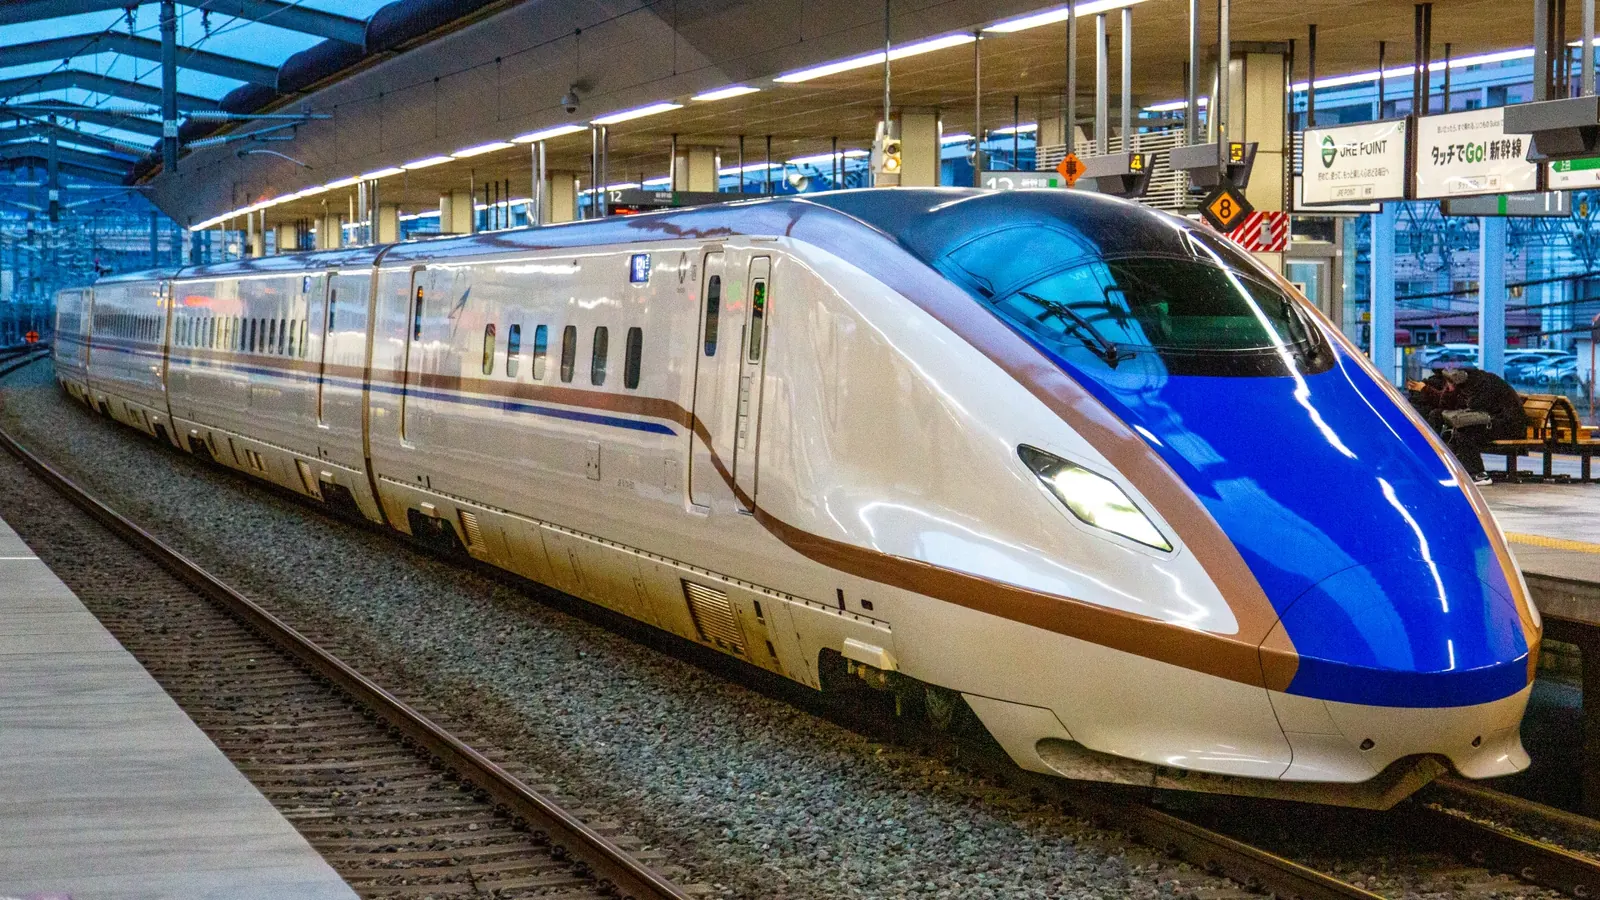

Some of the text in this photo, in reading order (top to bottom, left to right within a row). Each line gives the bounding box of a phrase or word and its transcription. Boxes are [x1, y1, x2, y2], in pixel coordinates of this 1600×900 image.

[1231, 143, 1242, 161] 5
[1360, 139, 1388, 156] POINT
[1489, 138, 1522, 160] 新幹線
[1130, 154, 1142, 169] 4
[609, 191, 622, 203] 12
[1545, 190, 1562, 212] 11
[1219, 198, 1232, 219] 8
